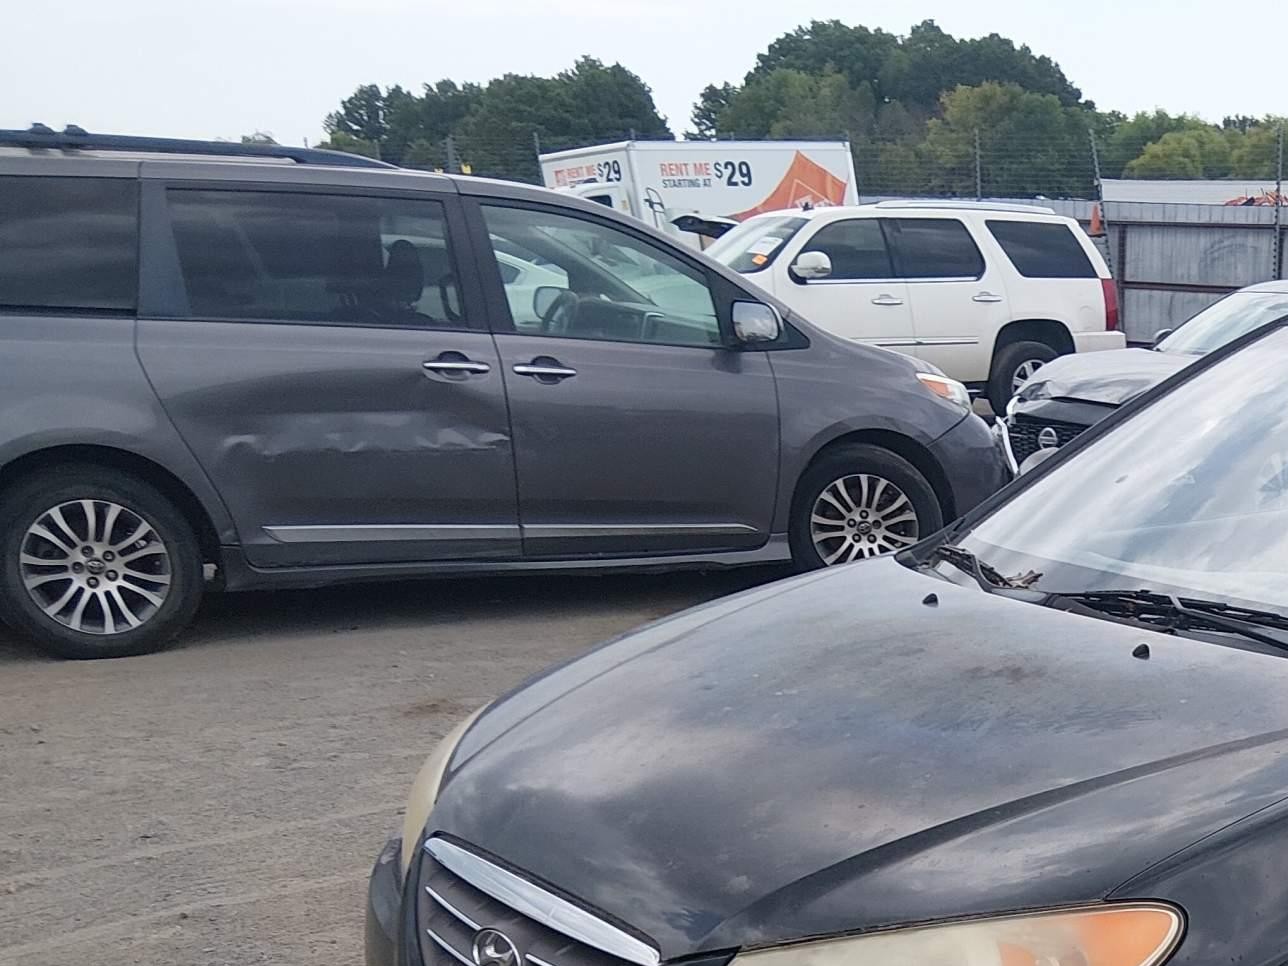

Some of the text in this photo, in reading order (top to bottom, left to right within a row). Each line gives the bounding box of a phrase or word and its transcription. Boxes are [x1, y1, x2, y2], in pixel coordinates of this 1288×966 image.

[597, 160, 622, 182] $29
[660, 161, 752, 186] RENT ME $29
[662, 178, 712, 188] STARTING AT
